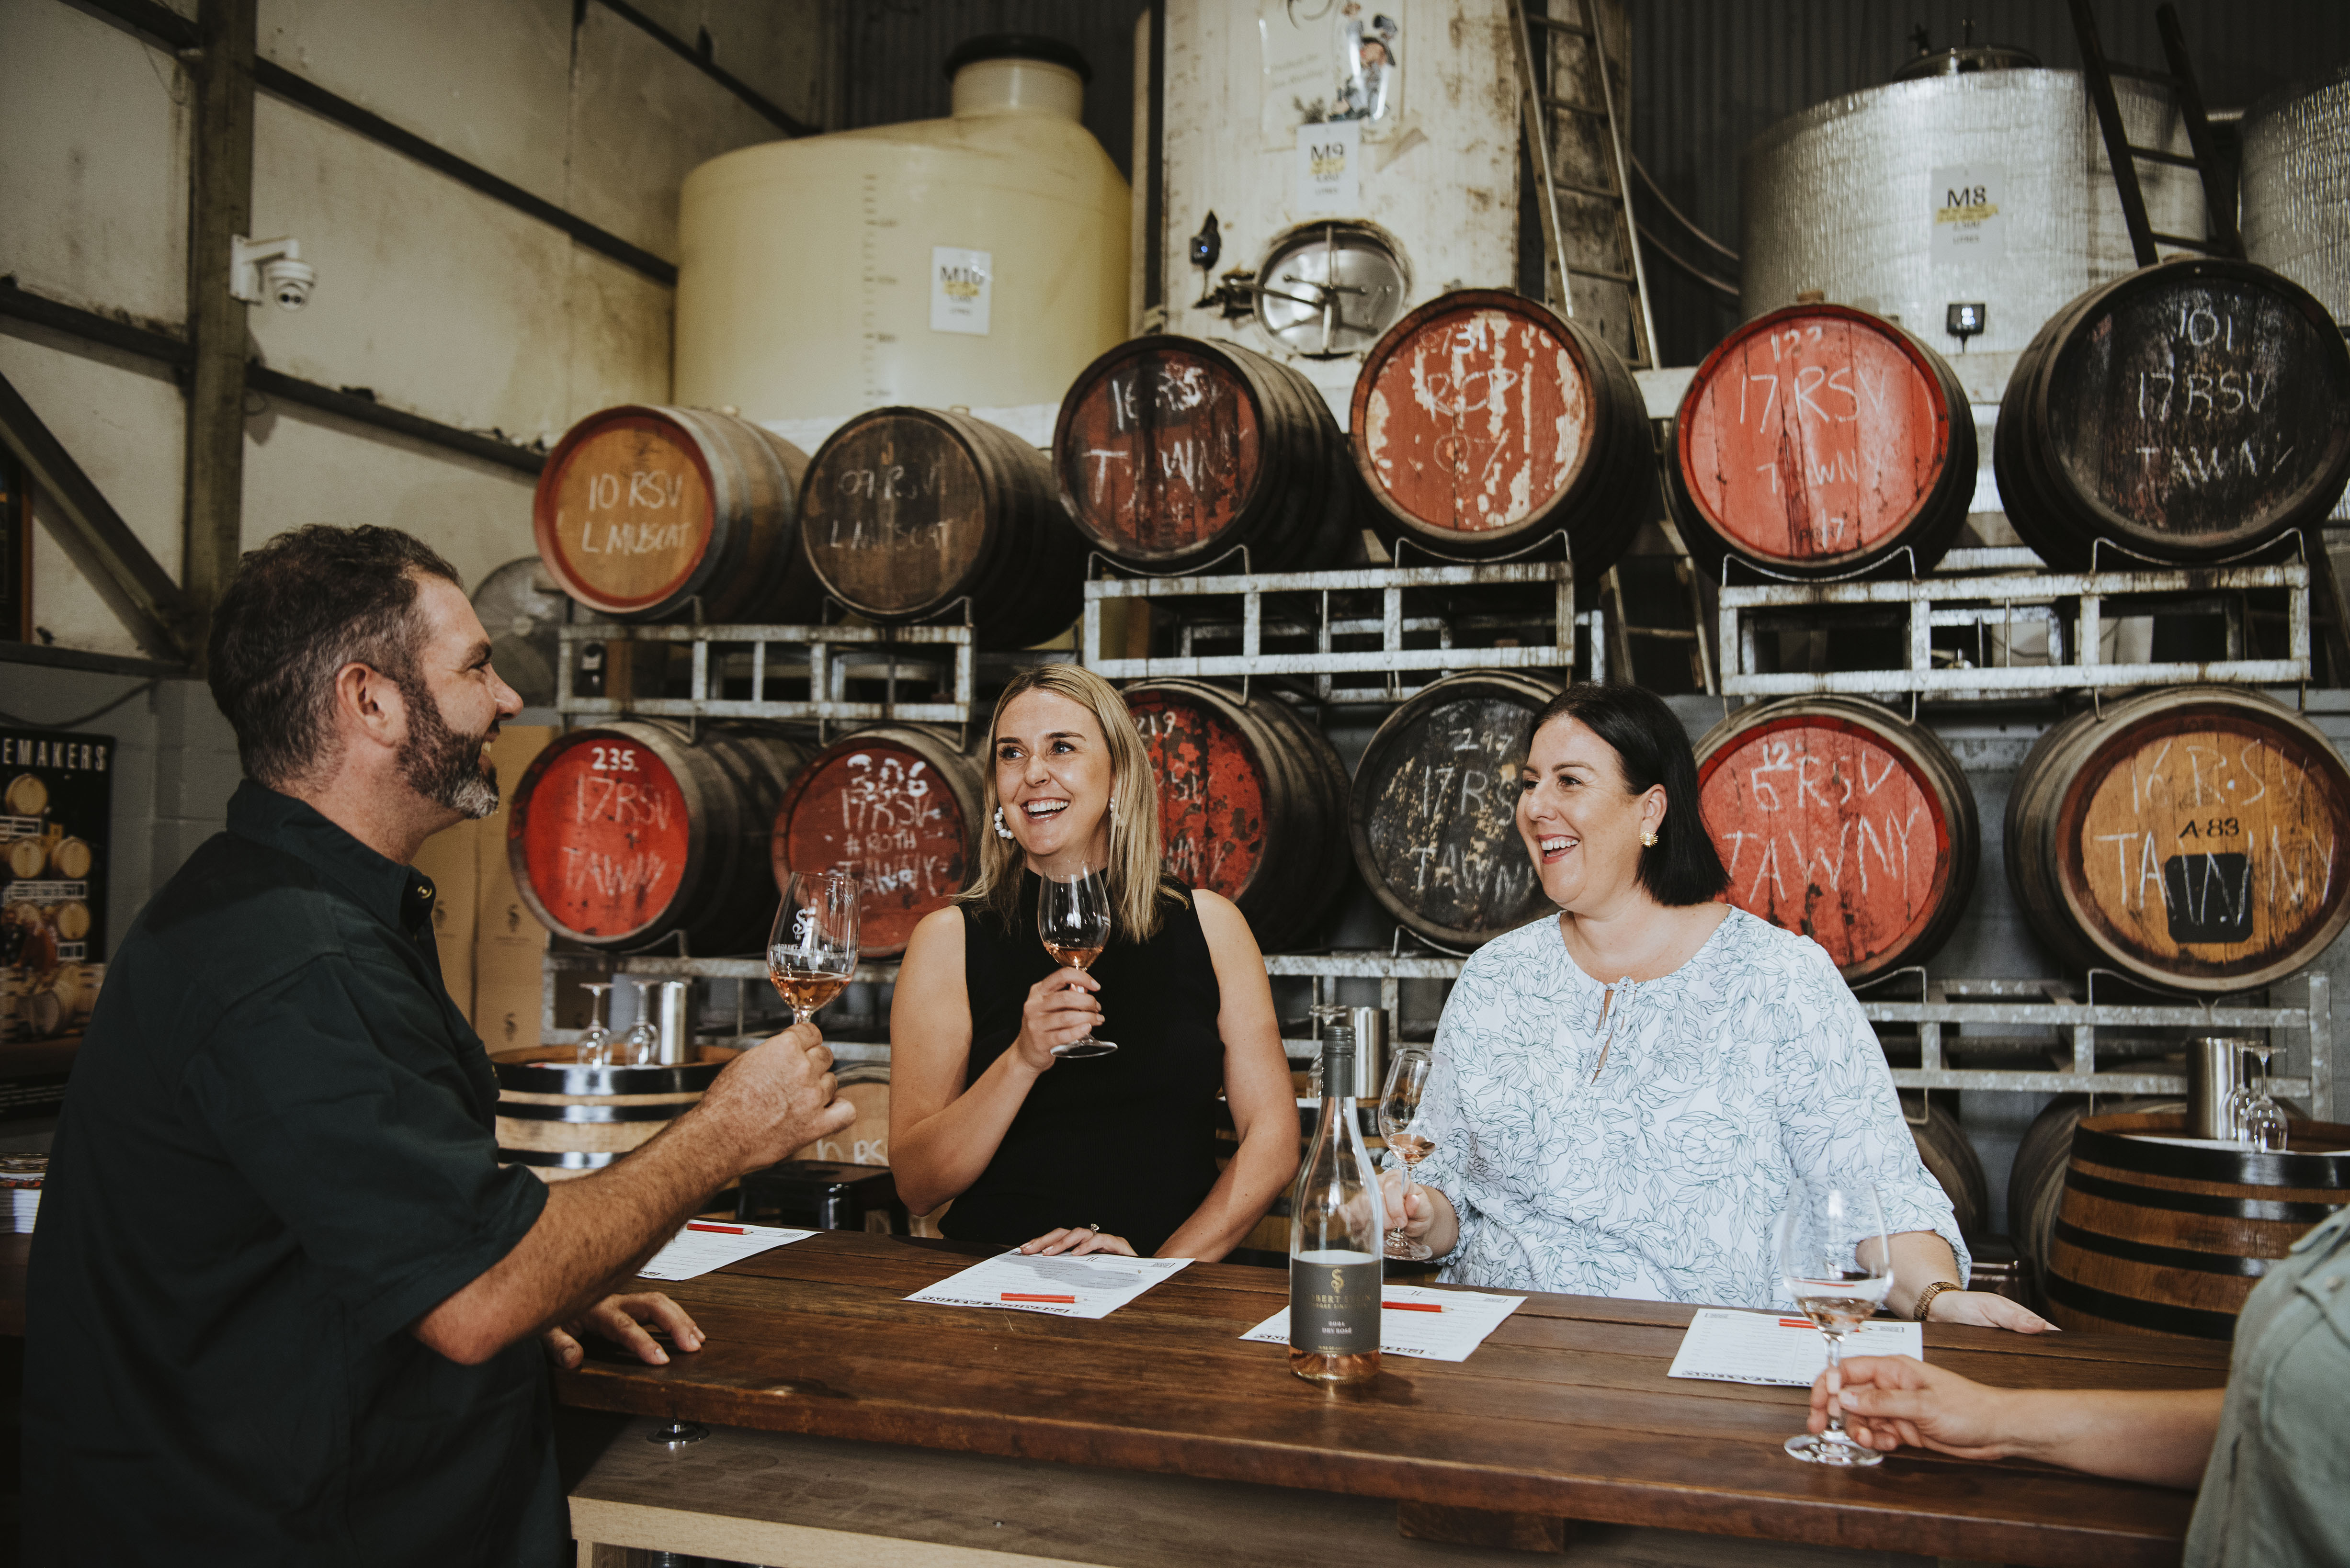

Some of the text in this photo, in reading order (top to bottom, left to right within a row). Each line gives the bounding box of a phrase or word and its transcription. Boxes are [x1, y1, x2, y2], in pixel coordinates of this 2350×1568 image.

[1948, 185, 1986, 208] M8
[1756, 447, 1881, 493] TWNY
[1723, 808, 1918, 904] TAWNY
[2093, 824, 2335, 927] TAWNY
